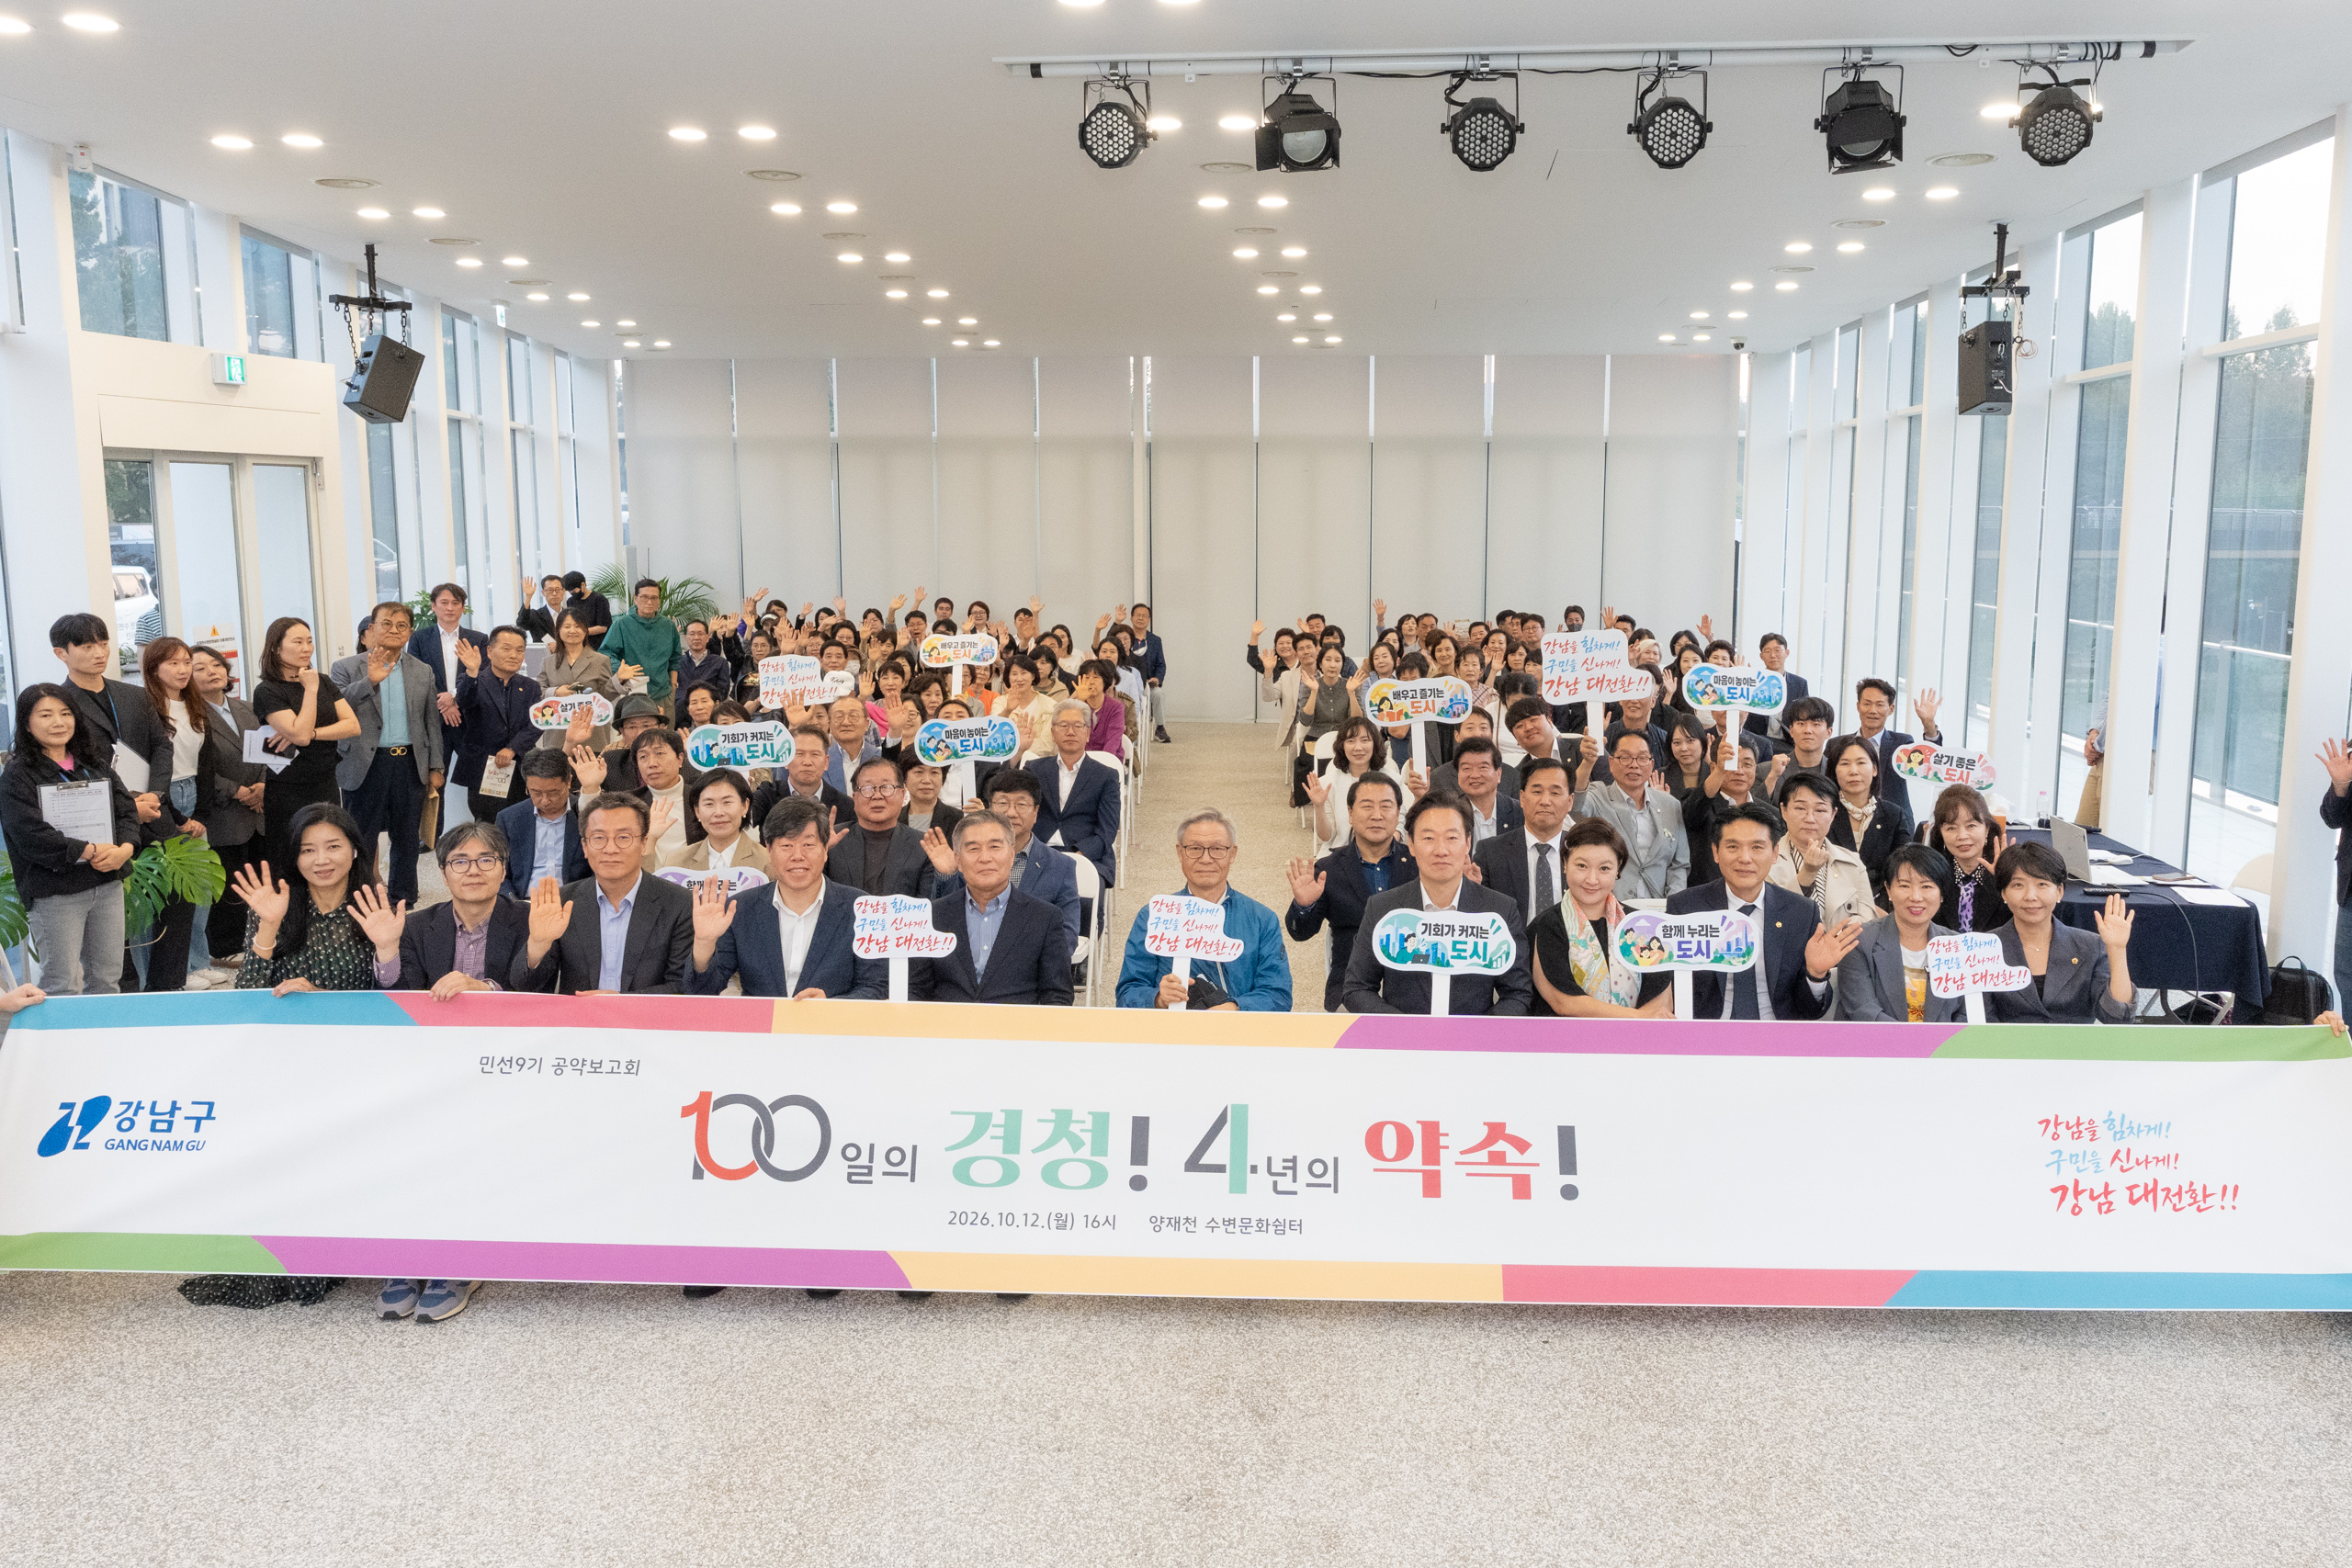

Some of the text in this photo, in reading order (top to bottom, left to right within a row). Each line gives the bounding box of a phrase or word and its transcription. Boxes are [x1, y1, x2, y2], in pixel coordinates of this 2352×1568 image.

[941, 641, 959, 649] 배우고
[1544, 636, 1621, 654] 강남을 힘차게!
[952, 649, 971, 660] 도시
[761, 659, 816, 673] 강남을 힘차게!
[1544, 657, 1621, 674] 구민을 신나게!
[762, 675, 786, 687] 구민을
[788, 673, 817, 684] 신나게!
[1544, 673, 1650, 698] 강남 대전환!!
[1713, 674, 1757, 687] 마음이 놓이는
[1392, 688, 1444, 700] 배우고 즐기는
[1726, 686, 1750, 701] 도시
[560, 702, 576, 712] 살기
[1410, 700, 1436, 715] 도시
[721, 731, 775, 744] 기회가 커지는
[944, 727, 989, 739] 마음이 놓이는
[746, 742, 775, 760] 도시
[959, 738, 983, 752] 도시
[1933, 752, 1976, 771] 살기 좋은
[1943, 767, 1971, 784] 도시
[855, 897, 928, 914] 강남을 힘차게!
[1152, 898, 1220, 917] 강남을 힘차게!
[855, 917, 928, 932] 구민을 신나게!
[1149, 917, 1218, 933] 구민을 신나게!
[1420, 922, 1489, 939] 기회가 커지는
[1661, 924, 1720, 938] 함께 누리는
[855, 933, 954, 953] 강남 대전환!!
[1148, 931, 1242, 956] 강남 대전환!!
[1450, 940, 1488, 962] 도시
[1676, 940, 1711, 959] 도시
[1928, 935, 1997, 954] 강남을 힘차게!
[1931, 953, 2000, 972] 구민을 신나게!
[1933, 969, 2028, 993] 강남 대전환!!
[479, 1055, 641, 1077] 민선9기 공약보고회
[114, 1100, 217, 1134] 강남구
[2037, 1110, 2172, 1143] 강남을 힘차게!
[185, 1140, 207, 1152] GU
[944, 1108, 1150, 1192] 경청!
[1364, 1120, 1580, 1201] 약속!
[2044, 1147, 2179, 1177] 구민을 신나게!
[2049, 1178, 2240, 1217] 강남 대전환!!
[947, 1211, 1304, 1235] 2026.10.12.(월) 16시 양재천 수변문화쉼터
